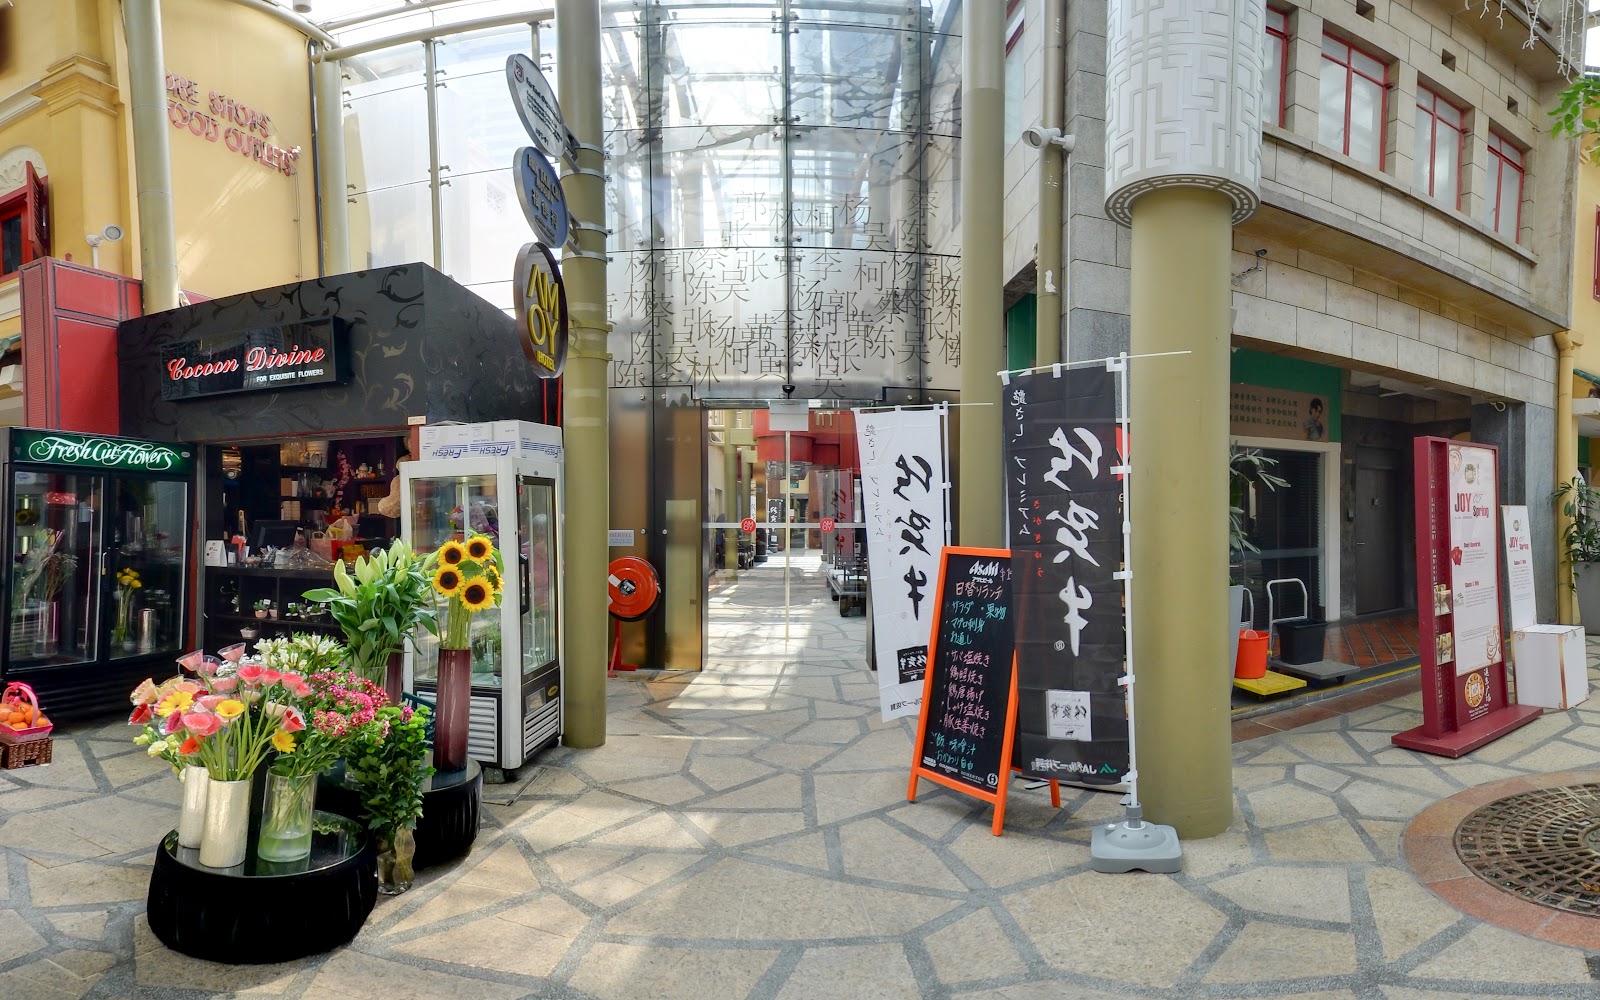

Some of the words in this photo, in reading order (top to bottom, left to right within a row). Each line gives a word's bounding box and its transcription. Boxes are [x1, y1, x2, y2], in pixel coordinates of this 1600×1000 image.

[208, 90, 270, 138] SHOPS
[165, 97, 219, 142] OOD
[223, 128, 292, 176] OUTLETS
[715, 269, 750, 304] 吴
[853, 256, 887, 292] 柯
[167, 357, 239, 381] Cocoon
[245, 344, 325, 372] Divine
[536, 349, 556, 372] HOTEL
[256, 375, 267, 383] FOR
[269, 371, 296, 382] EXQUISITE
[297, 368, 324, 378] FLOWERS
[29, 436, 93, 463] Fresh
[90, 438, 121, 464] Cut
[102, 443, 180, 471] Flowers
[1454, 492, 1472, 513] JOY
[1473, 505, 1489, 519] Spring
[969, 560, 1000, 577] Asahi
